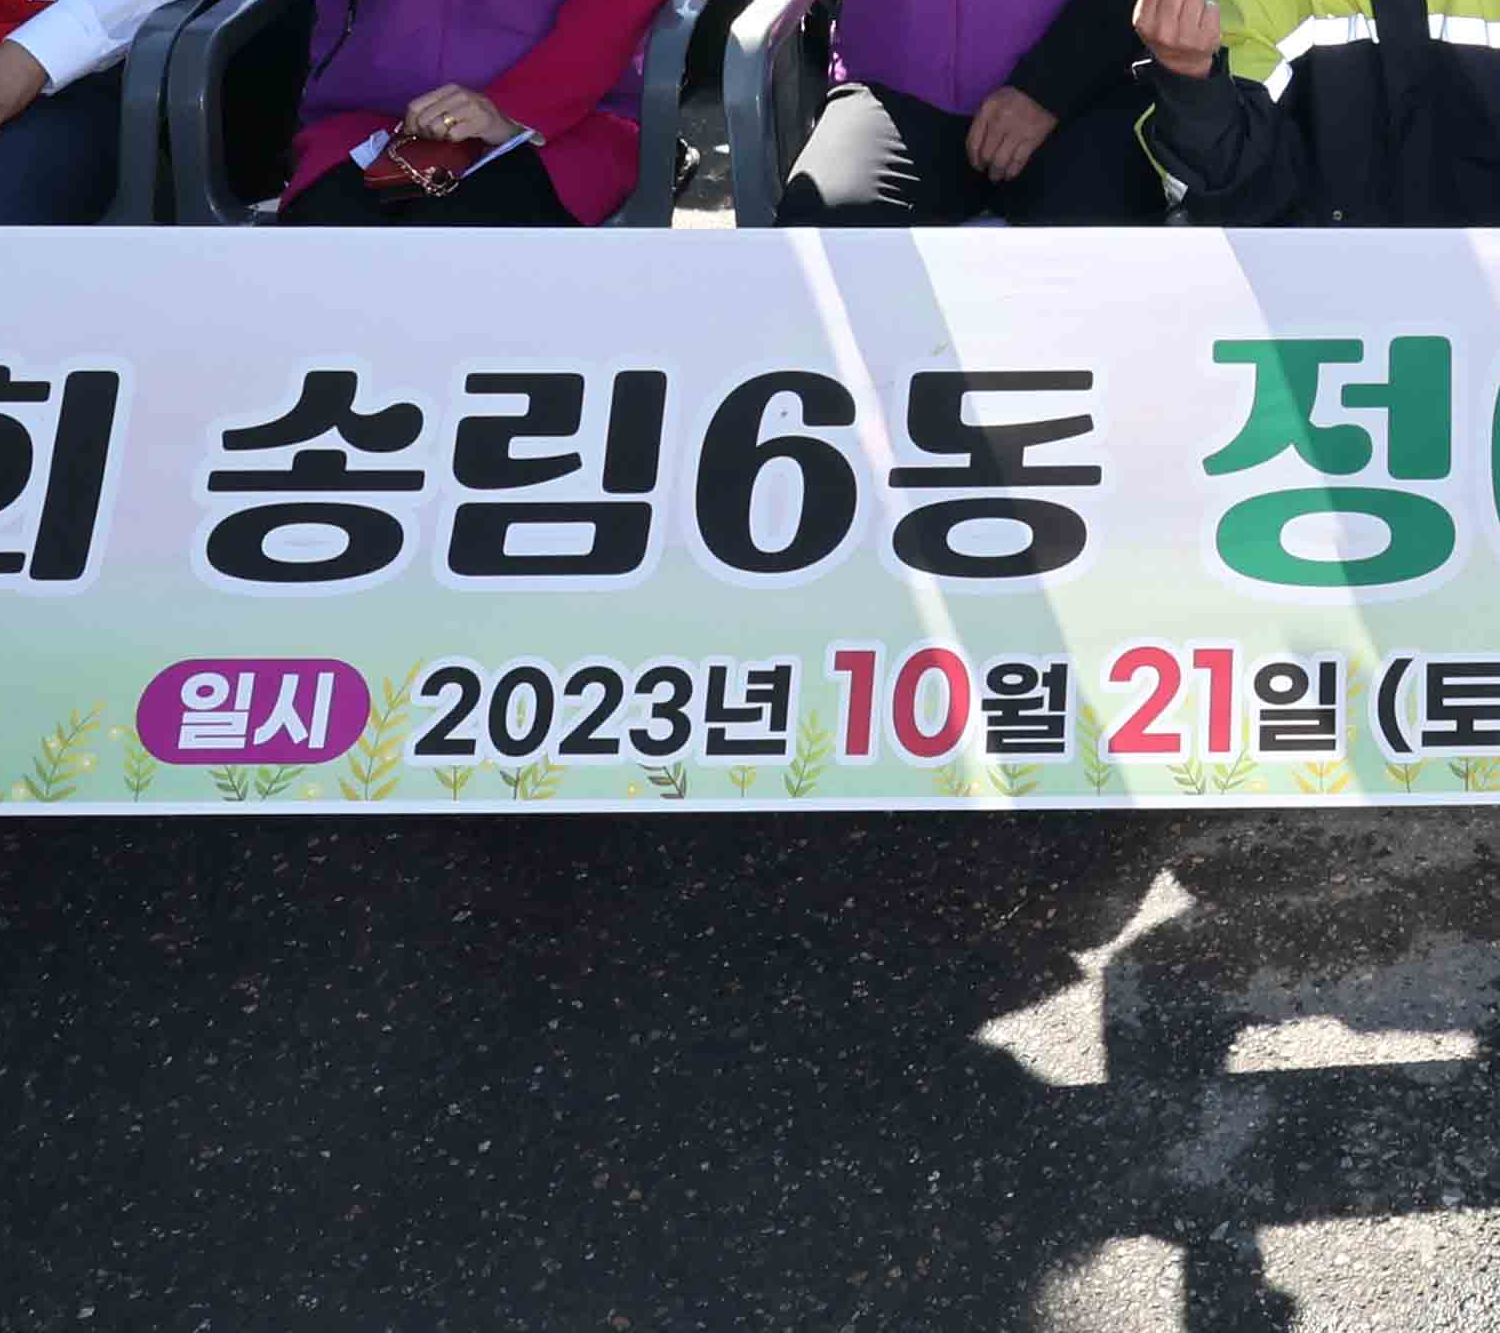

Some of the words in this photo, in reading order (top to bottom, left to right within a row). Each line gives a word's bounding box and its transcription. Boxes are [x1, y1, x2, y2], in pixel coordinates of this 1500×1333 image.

[205, 369, 1104, 584] 송림6동
[179, 672, 336, 753] 일시
[413, 663, 793, 760] 2023년
[833, 648, 1071, 760] 10월
[1107, 645, 1340, 756] 21일
